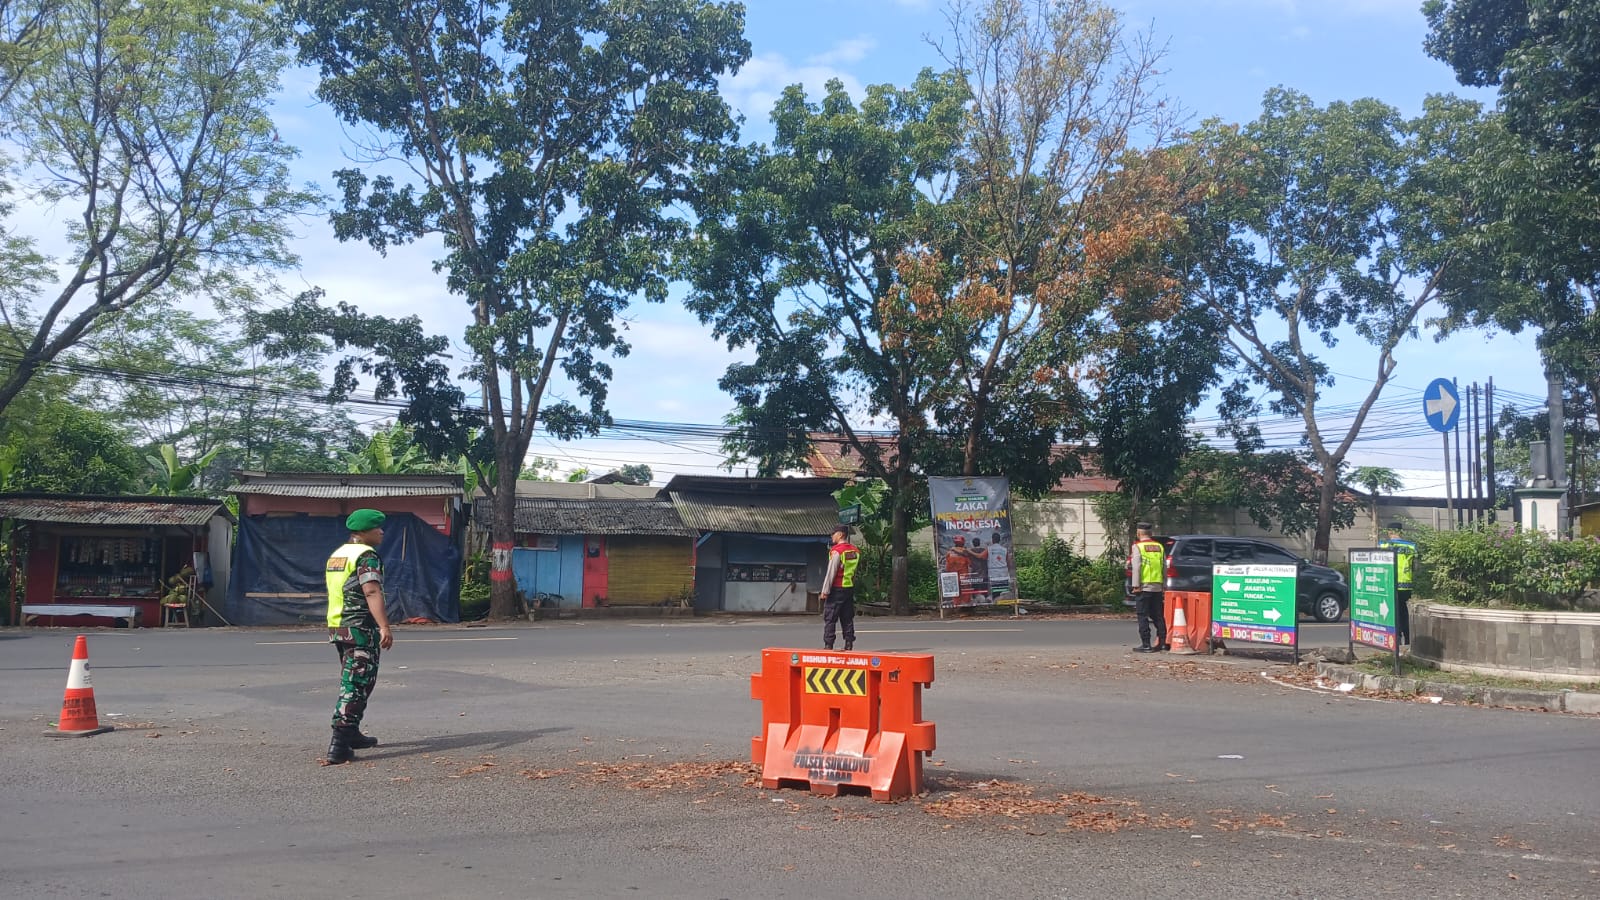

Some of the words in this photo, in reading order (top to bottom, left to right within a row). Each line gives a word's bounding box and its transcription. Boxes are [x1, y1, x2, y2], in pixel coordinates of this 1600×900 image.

[955, 502, 988, 511] ZAKAT
[945, 519, 1001, 531] INDONESIA
[793, 755, 826, 770] POLSEK
[825, 756, 870, 774] SUKALUYU
